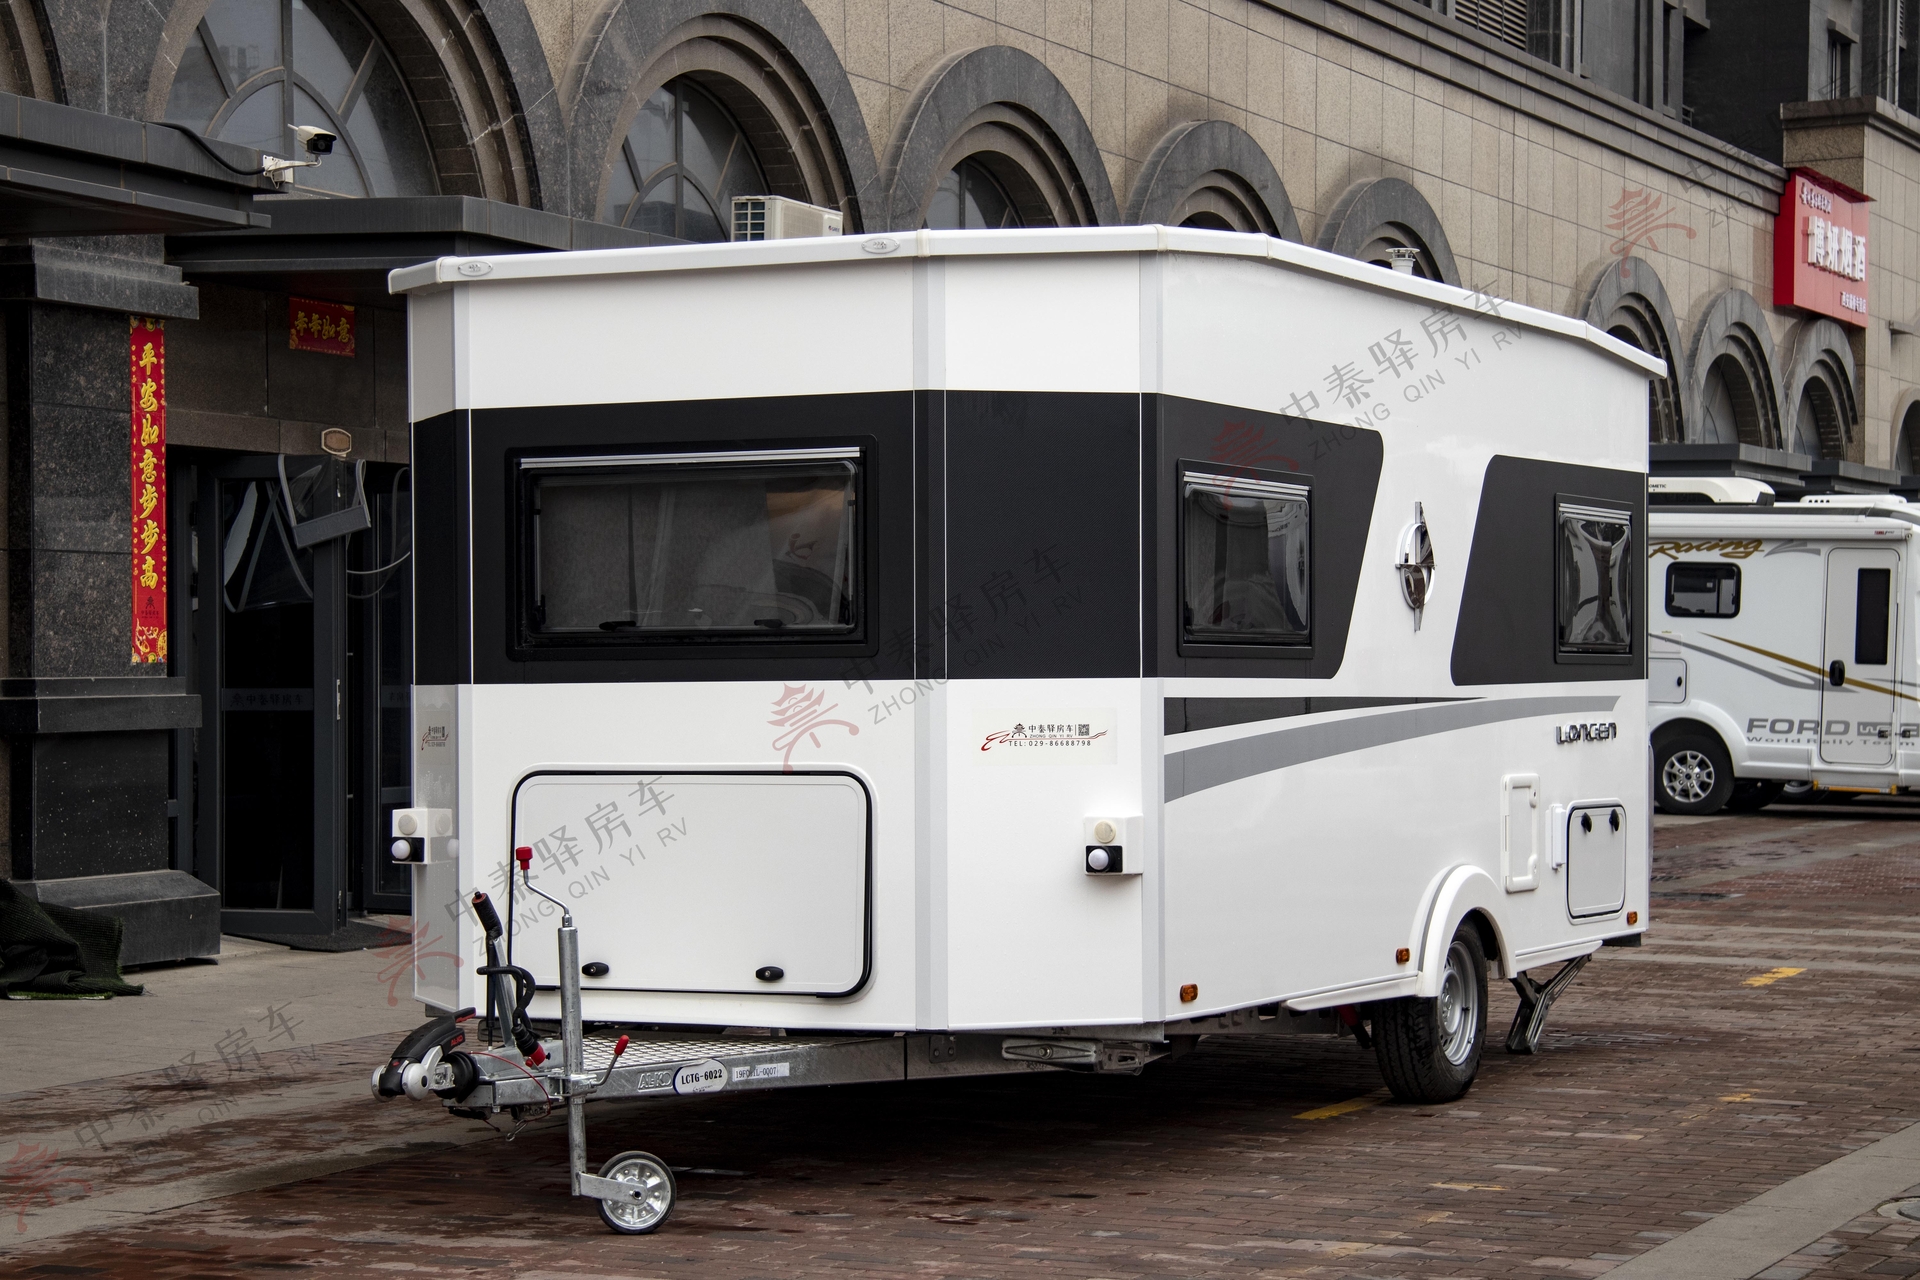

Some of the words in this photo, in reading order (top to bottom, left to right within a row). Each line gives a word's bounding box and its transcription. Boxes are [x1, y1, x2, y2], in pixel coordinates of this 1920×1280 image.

[139, 342, 159, 590] 平安如意步步高
[1648, 538, 1764, 560] Racing
[1746, 717, 1851, 736] FORD
[1746, 736, 1801, 744] World
[1806, 737, 1854, 746] Rally
[681, 1068, 723, 1085] LCTG-6022
